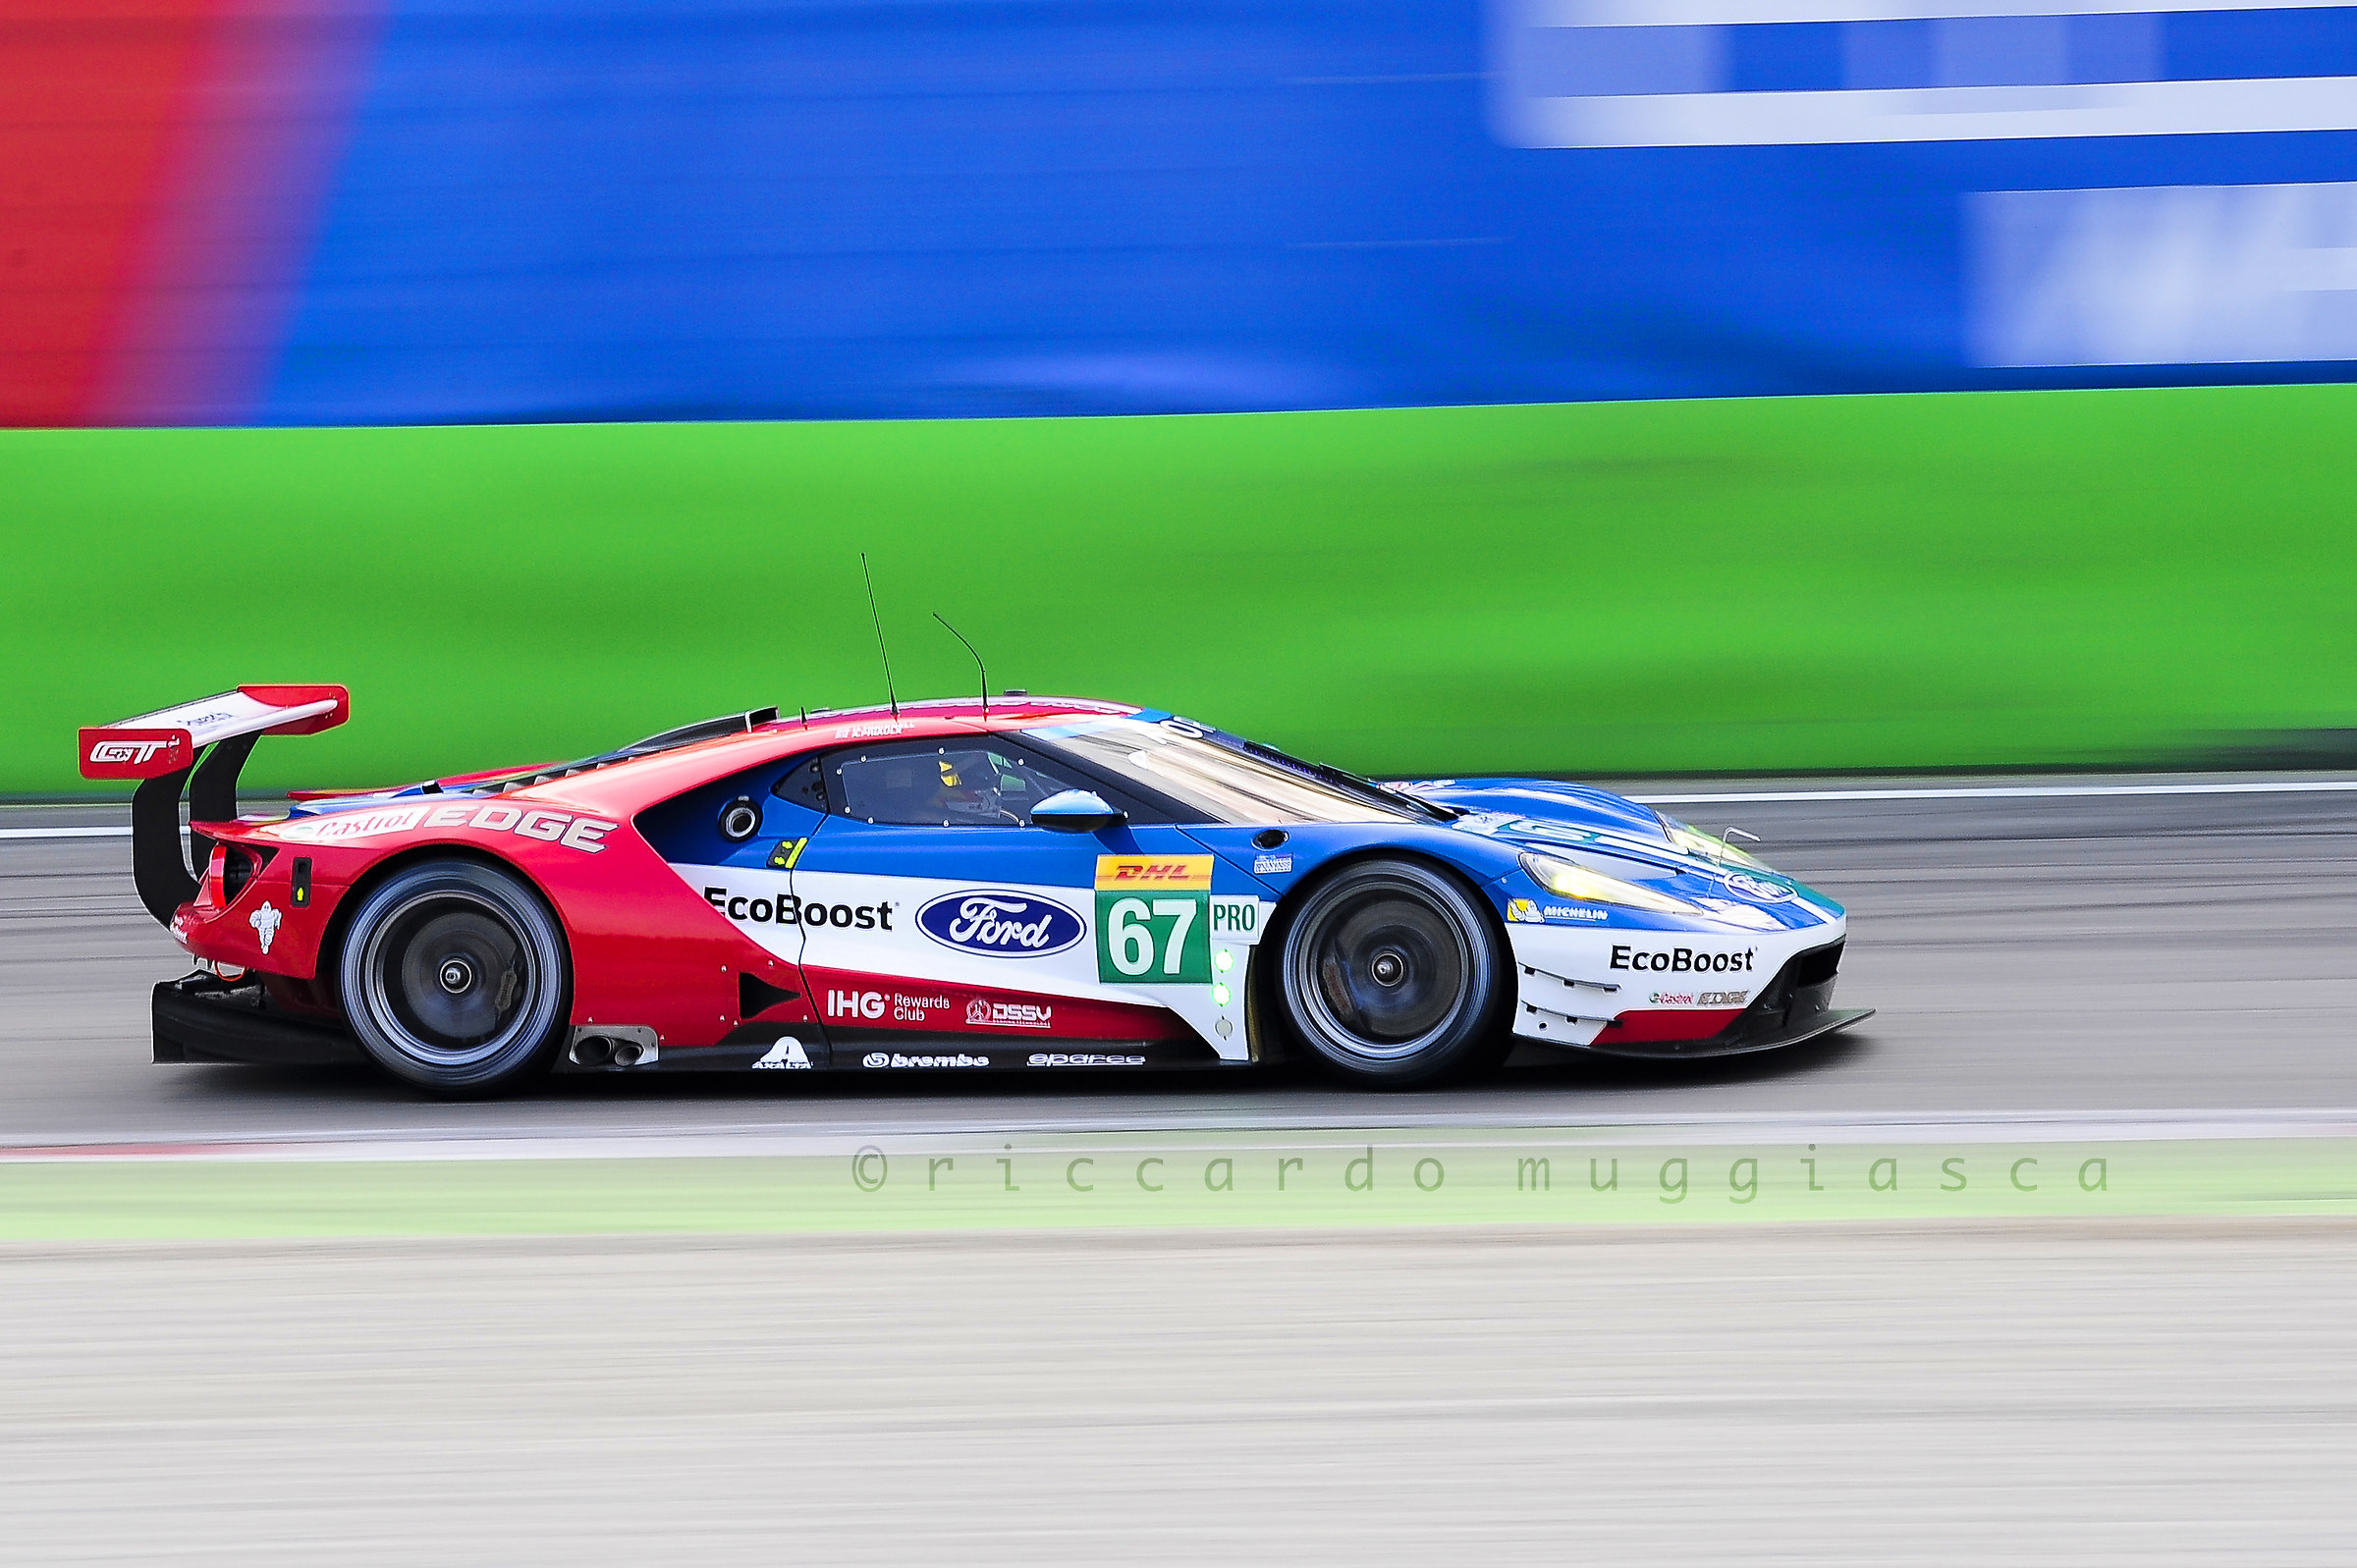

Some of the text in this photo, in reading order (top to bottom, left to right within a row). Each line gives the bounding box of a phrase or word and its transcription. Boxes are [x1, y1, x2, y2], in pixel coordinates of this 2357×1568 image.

[89, 740, 168, 765] GT
[316, 804, 620, 853] Castrol EDGE
[1115, 865, 1190, 882] DHL
[703, 886, 894, 932] EcoBoost
[949, 896, 1053, 948] Ford
[1214, 904, 1256, 932] PRO
[1543, 905, 1609, 921] MICHELIN
[1108, 896, 1197, 976] 67
[1609, 944, 1755, 973] EcoBoost
[827, 989, 886, 1020] IHG
[893, 1005, 926, 1022] Club
[894, 992, 951, 1010] Rewards
[891, 1053, 991, 1068] brembo
